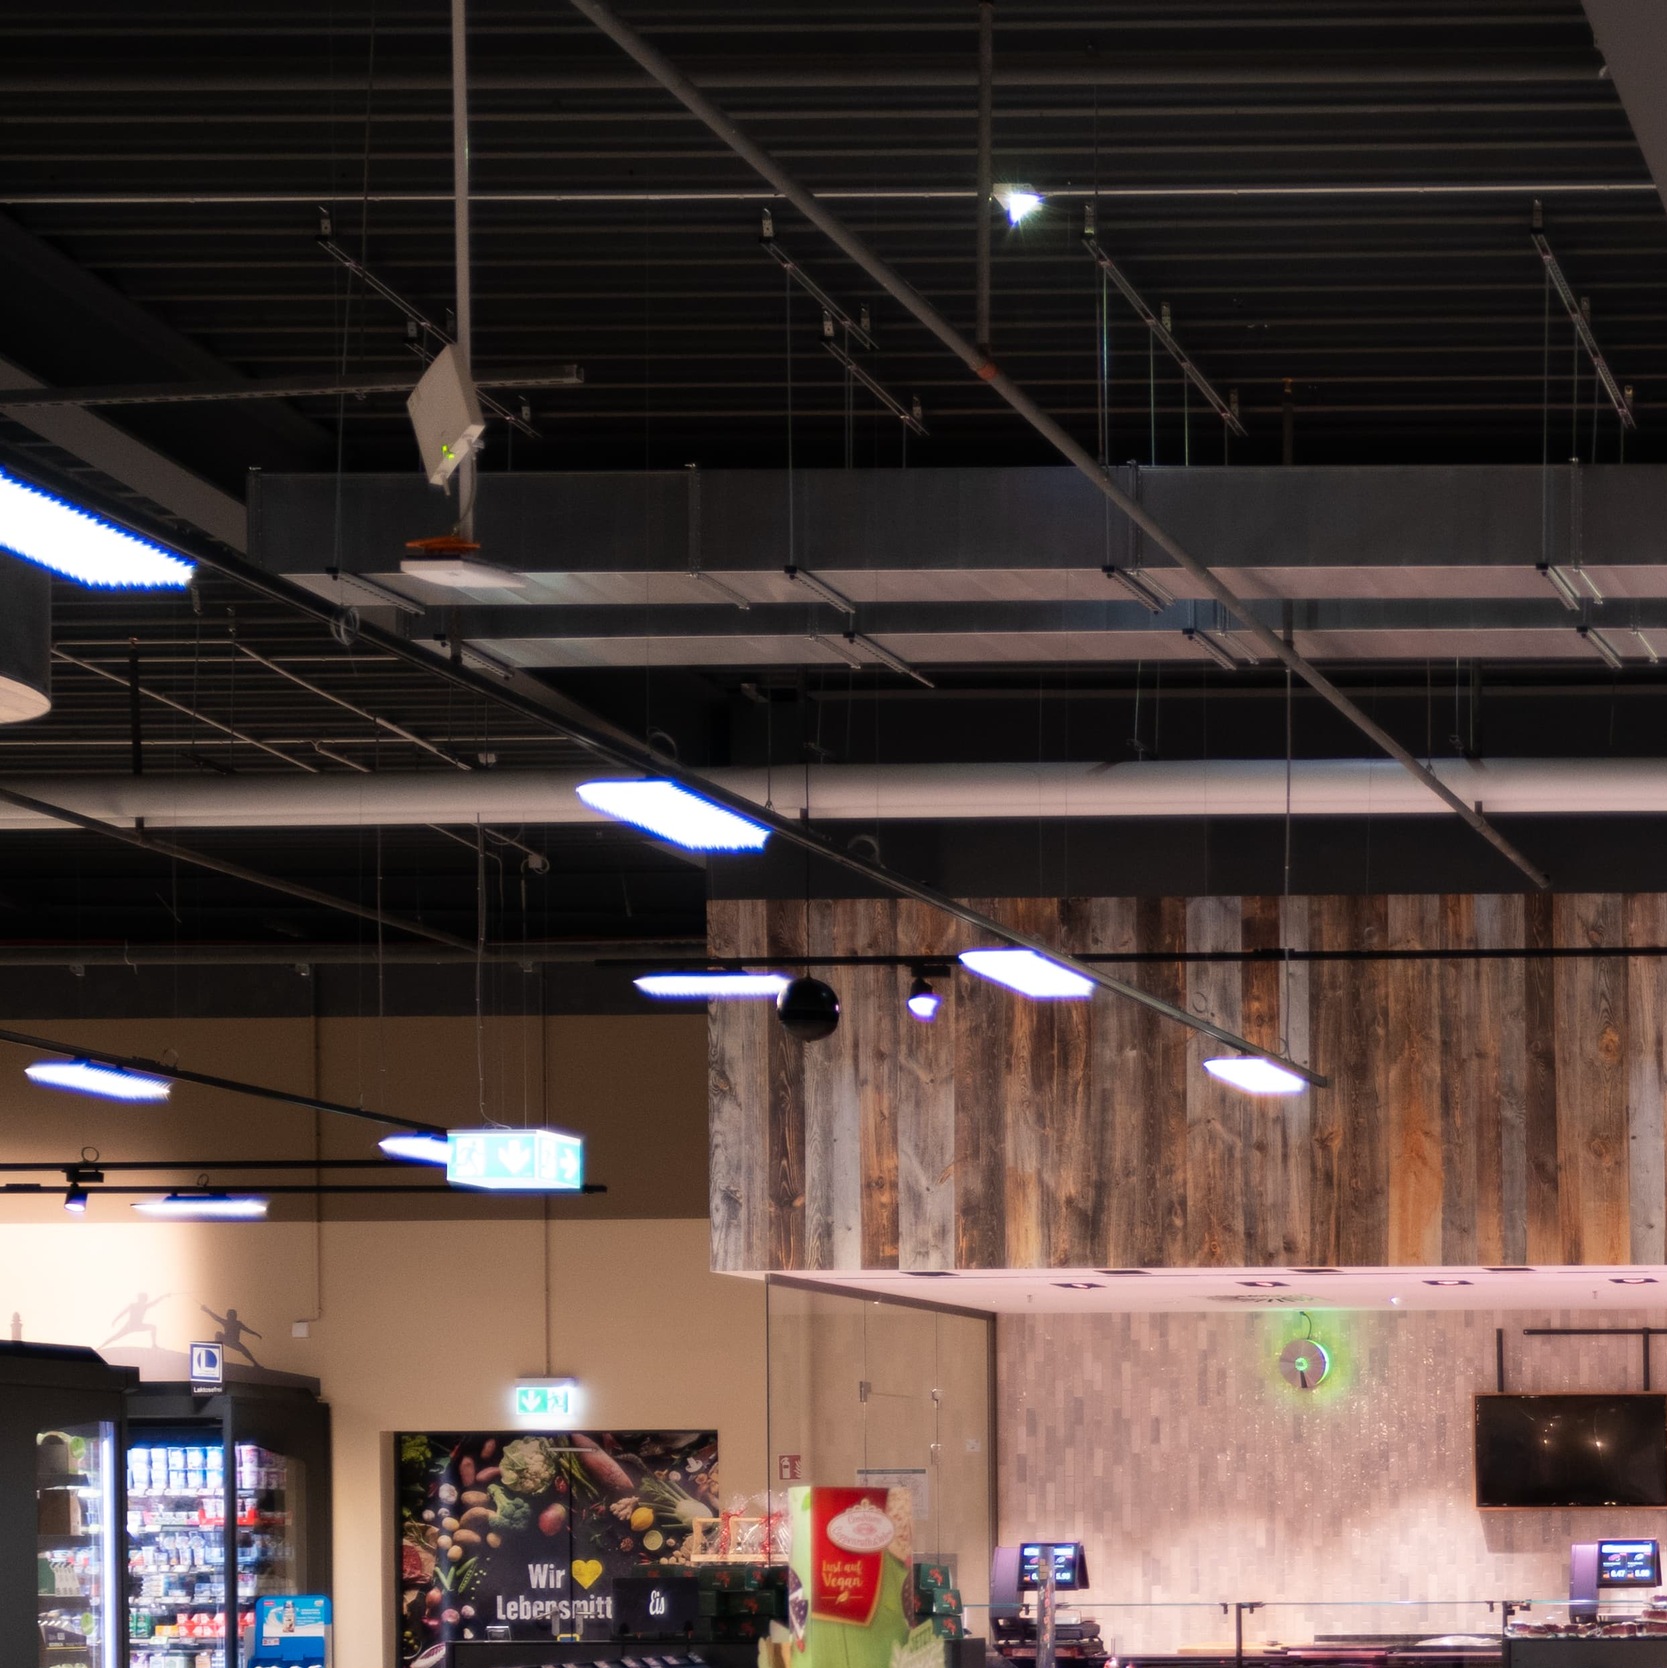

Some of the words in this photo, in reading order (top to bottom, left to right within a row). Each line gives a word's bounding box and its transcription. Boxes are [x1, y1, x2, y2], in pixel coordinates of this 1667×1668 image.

[527, 1563, 566, 1589] Wir
[822, 1572, 863, 1592] Vegan
[496, 1593, 613, 1620] Lebensmitt
[648, 1589, 666, 1616] Eis
